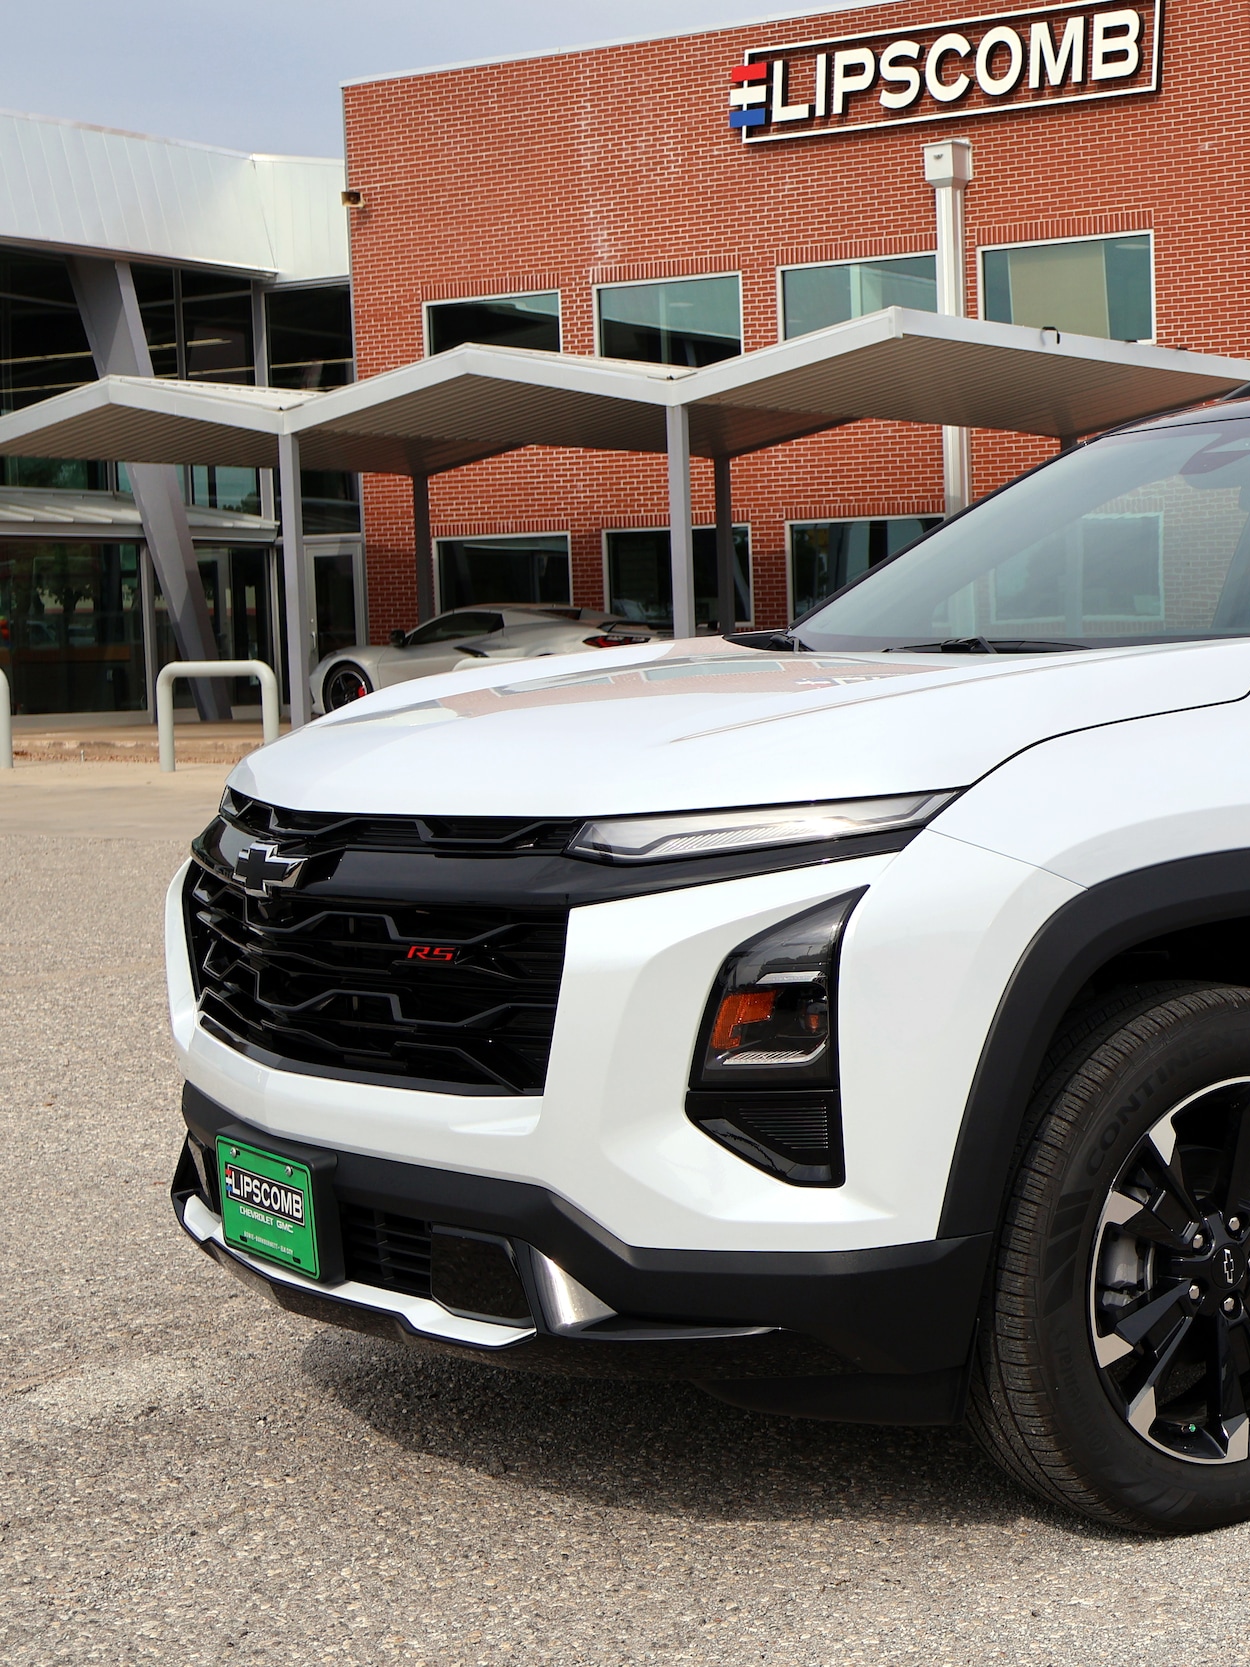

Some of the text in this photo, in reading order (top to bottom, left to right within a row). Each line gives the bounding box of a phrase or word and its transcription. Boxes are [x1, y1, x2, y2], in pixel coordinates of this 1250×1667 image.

[771, 8, 1141, 123] LIPSCOMB
[406, 945, 457, 961] RS
[232, 1170, 303, 1219] LIPSCOMB
[239, 1205, 294, 1234] CHEVROLET GMC
